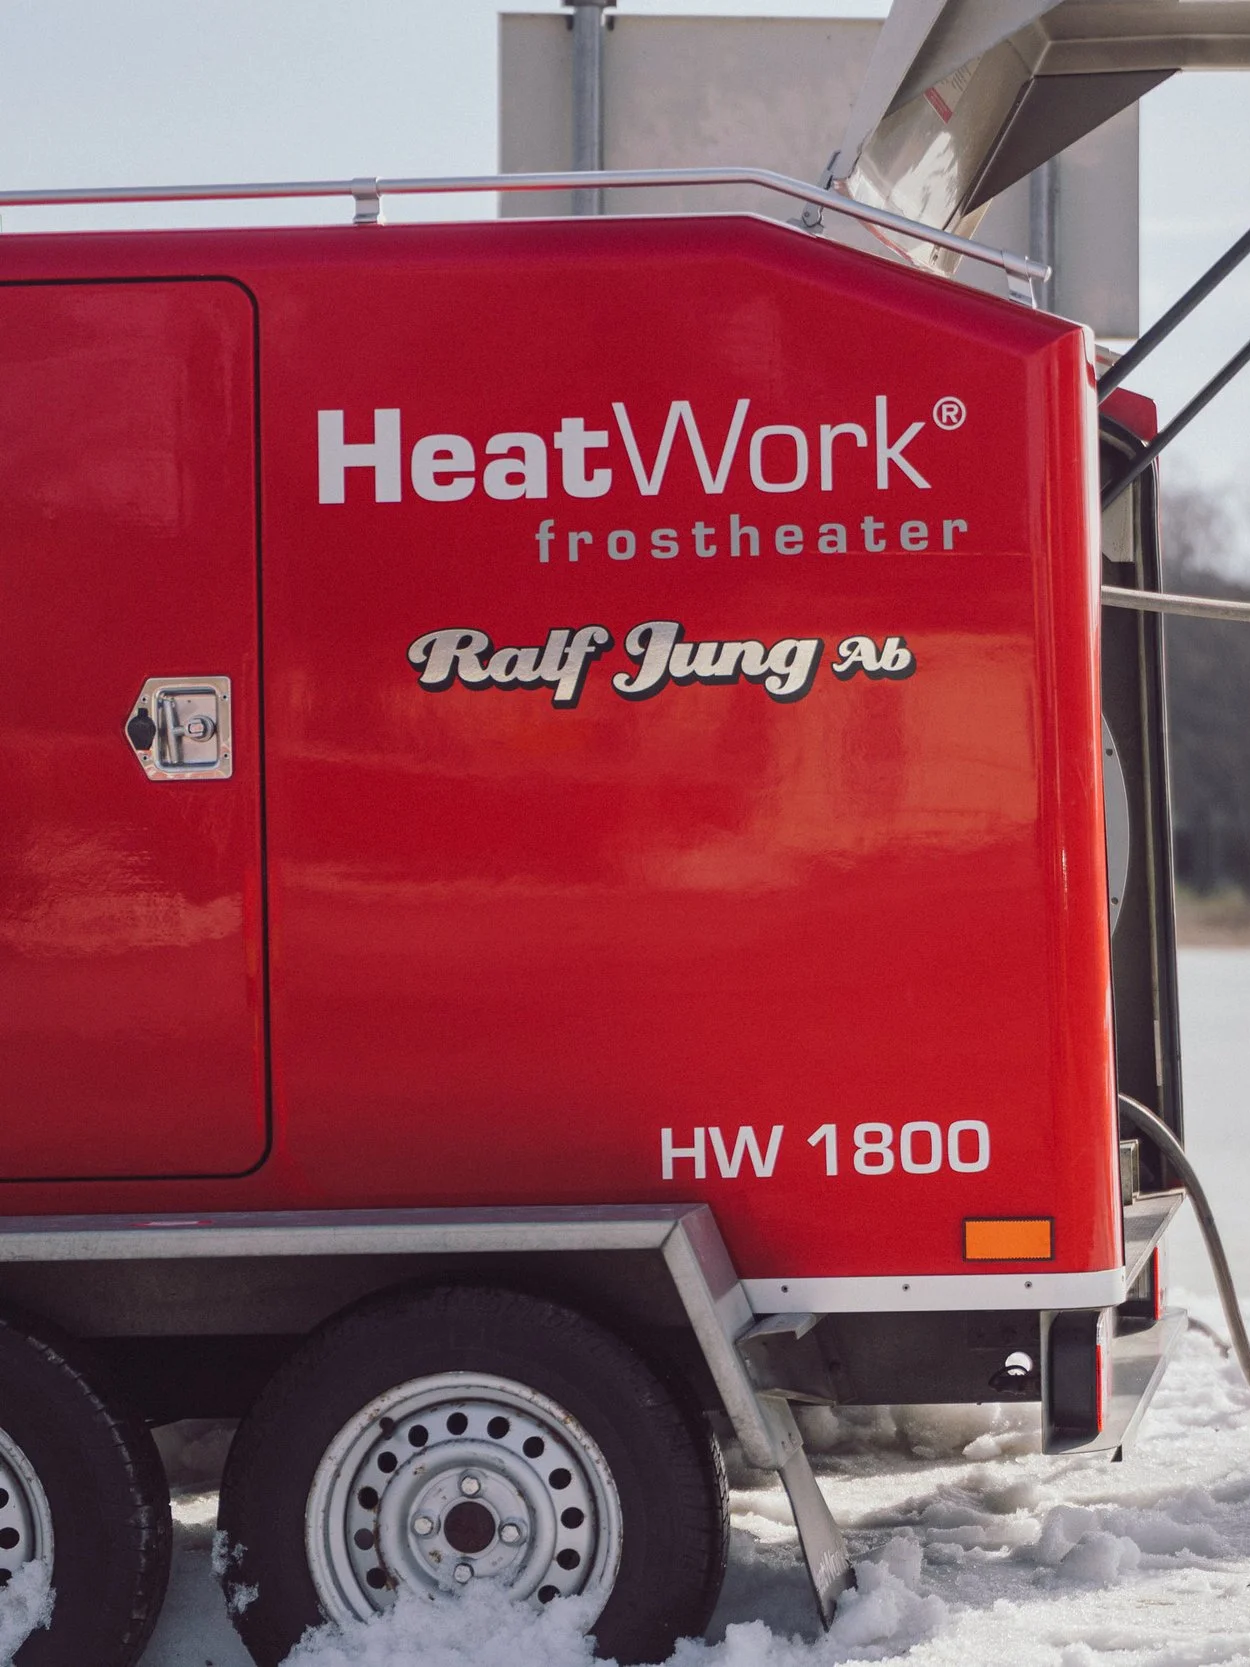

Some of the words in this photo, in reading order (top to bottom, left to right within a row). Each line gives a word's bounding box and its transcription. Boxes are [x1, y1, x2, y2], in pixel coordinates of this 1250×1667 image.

[535, 514, 969, 563] frostheater
[407, 624, 613, 709] Ralf
[612, 620, 825, 704] Jung
[831, 633, 916, 681] Ab
[661, 1125, 785, 1180] HW
[807, 1119, 991, 1176] 1800
